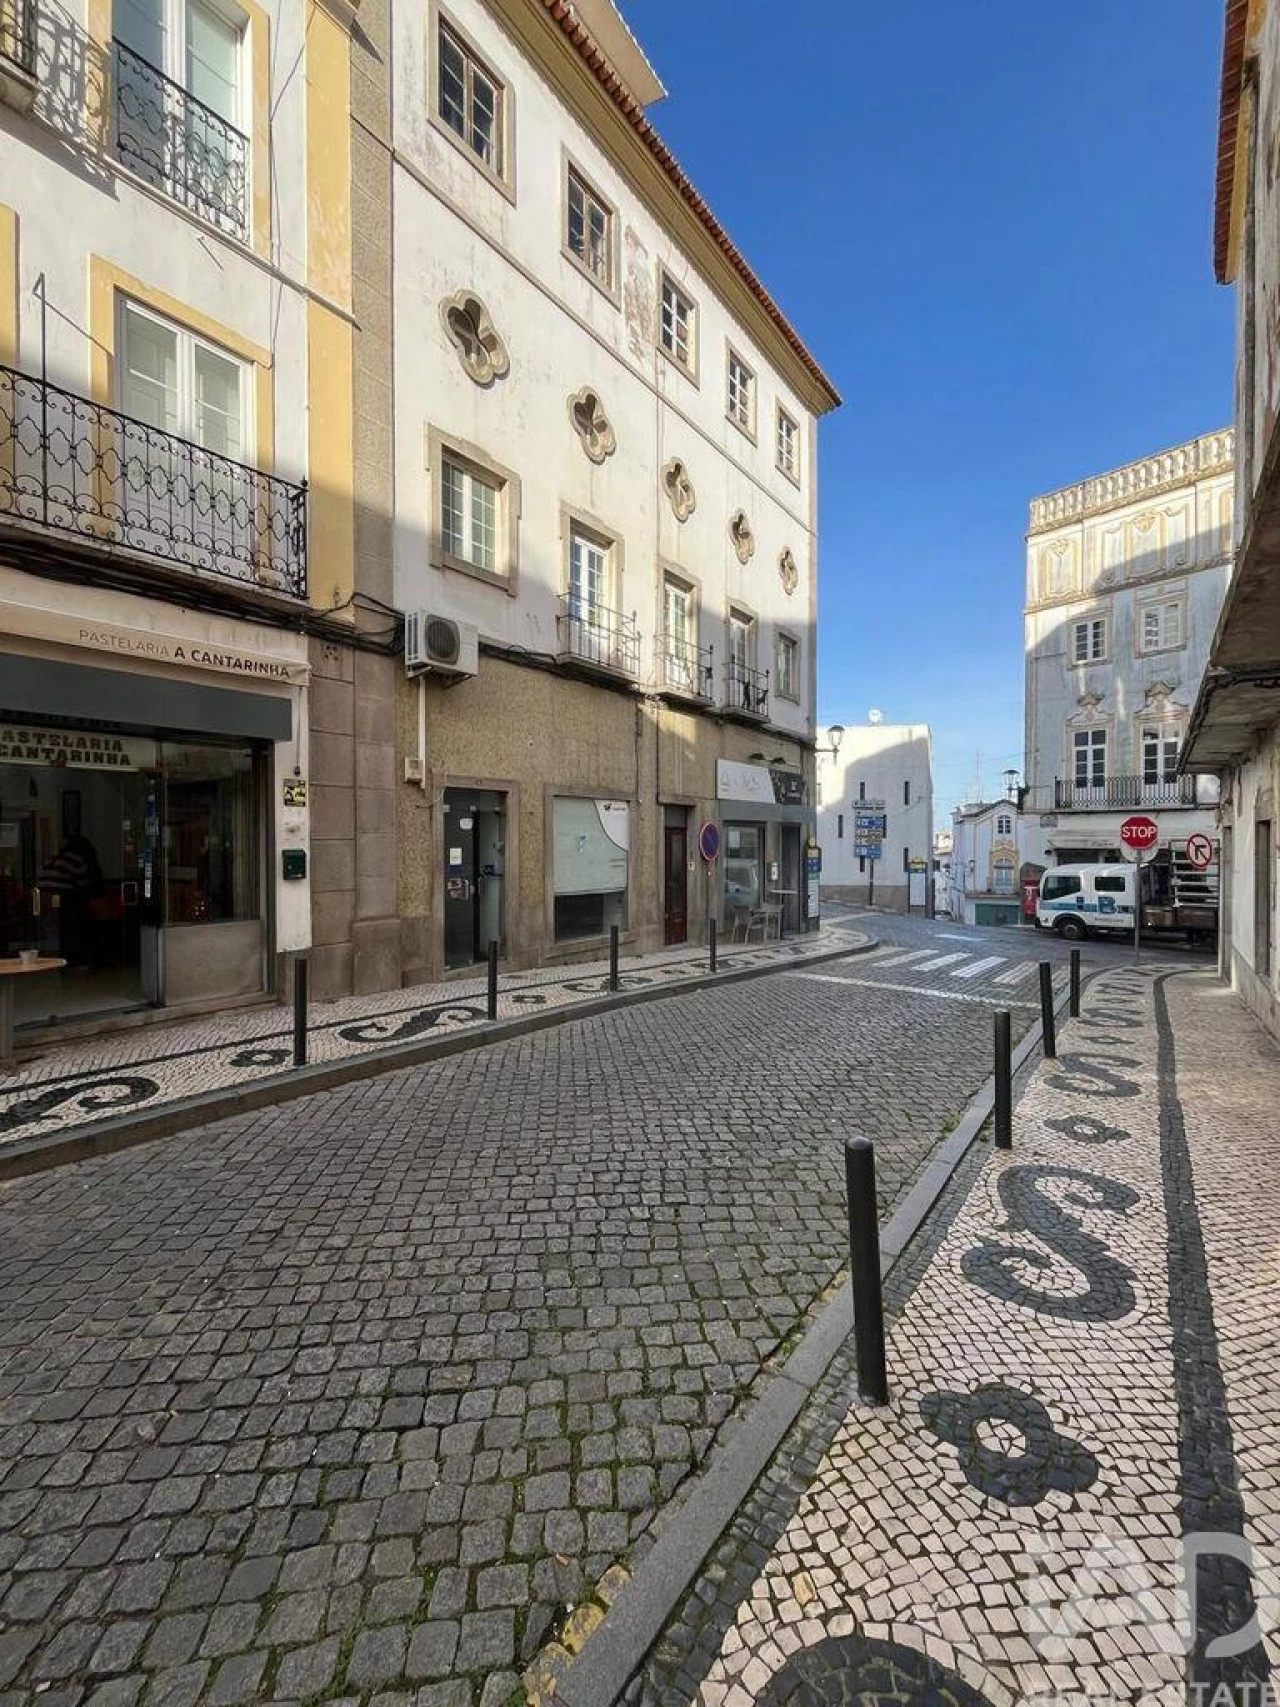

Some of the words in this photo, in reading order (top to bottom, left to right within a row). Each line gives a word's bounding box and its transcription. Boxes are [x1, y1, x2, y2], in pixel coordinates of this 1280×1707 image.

[79, 629, 169, 656] PASTELARIA
[174, 646, 186, 659] A
[191, 649, 291, 679] CANTARINHA
[1121, 826, 1157, 838] STOP
